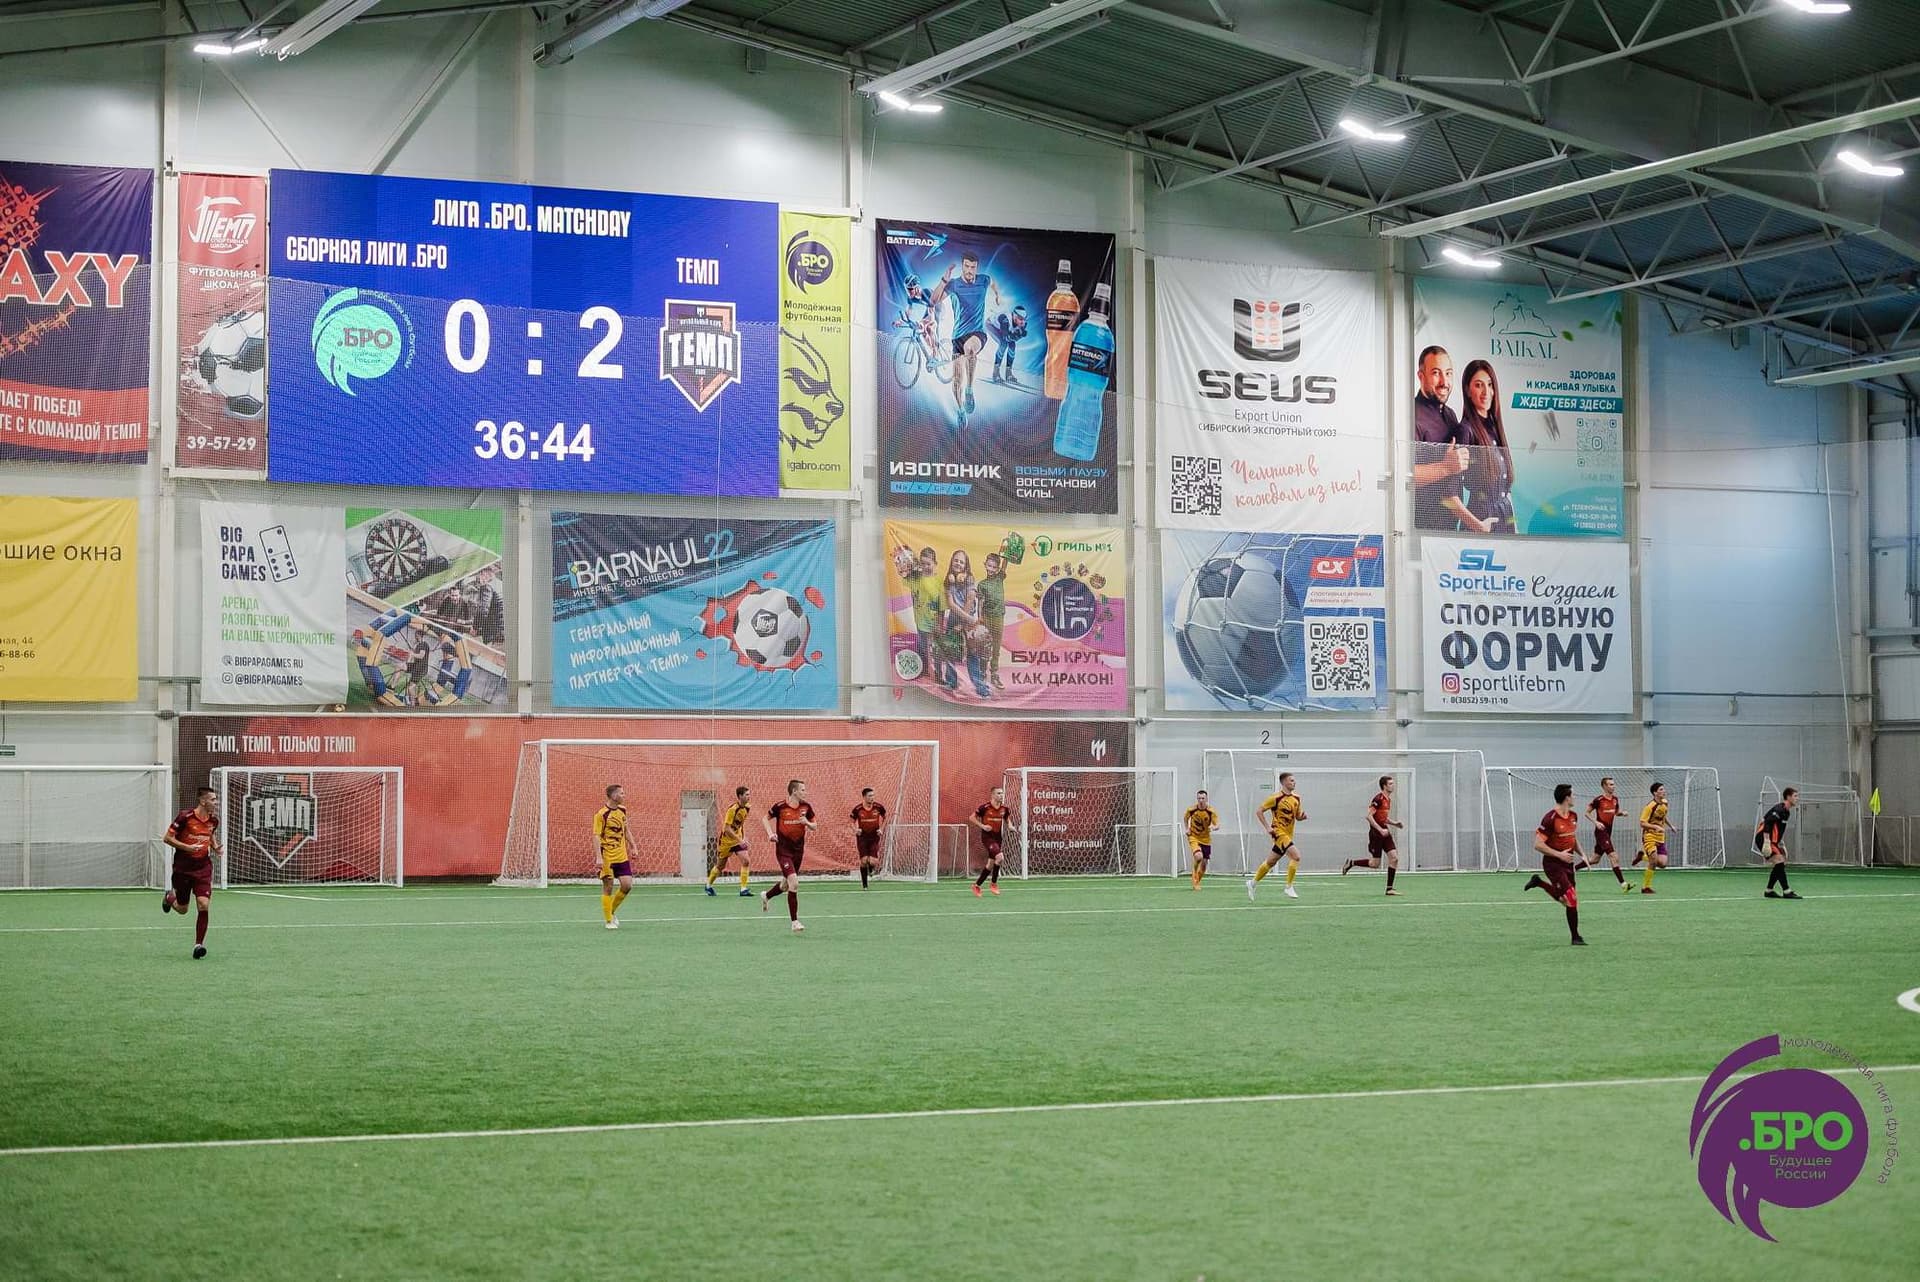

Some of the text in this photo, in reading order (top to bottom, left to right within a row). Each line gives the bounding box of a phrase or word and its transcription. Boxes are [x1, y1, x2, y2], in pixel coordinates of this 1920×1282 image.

[432, 198, 631, 238] ЛИГА .БРО. MATCHDAY
[286, 236, 447, 270] СБОРНАЯ ЛИГИ .БРО
[797, 253, 829, 269] .БРО
[188, 267, 257, 279] ФУТБОЛЬНАЯ
[676, 256, 719, 286] ТЕМП
[204, 280, 240, 290] ШКОЛА
[784, 299, 842, 313] Молодёжная
[785, 310, 842, 323] футбольная
[337, 327, 393, 350] .БРО
[444, 299, 490, 373] 0
[527, 321, 543, 376] :
[577, 306, 624, 379] 2
[820, 326, 842, 334] лига
[669, 332, 733, 371] ТЕМП
[1569, 370, 1616, 380] ЗДОРОВАЯ
[1197, 369, 1338, 404] SEUS
[1534, 381, 1580, 391] КРАСИВАЯ
[1582, 384, 1617, 393] УЛЫБКА
[33, 394, 82, 418] ПОБЕД!
[1519, 396, 1616, 411] ЖДЕТ ТЕБЯ ЗДЕСЬ!
[1234, 408, 1303, 423] Export Union
[16, 416, 25, 433] С
[28, 418, 101, 441] КОМАНДОЙ
[104, 423, 141, 440] ТЕМП!
[1198, 423, 1337, 437] СИБИРСКИЙ ЭКСПОРТНЫЙ СОЮЗ
[187, 436, 257, 451] 39-57-29
[474, 420, 595, 462] 36:44
[889, 461, 1001, 479] ИЗОТОНИК
[1015, 466, 1067, 477] ВОЗЬМИ
[1230, 454, 1320, 484] Чемпион в
[1016, 478, 1096, 488] ВОССТАНОВИ
[1235, 469, 1362, 507] каждом из нас!
[1016, 488, 1055, 498] СИЛЫ.
[220, 526, 242, 543] BIG
[0, 544, 123, 562] шие окна
[704, 528, 739, 560] 22
[1057, 542, 1093, 552] ГРИЛЬ
[221, 545, 255, 562] PAPA
[1457, 549, 1507, 571] SL
[221, 564, 266, 582] GAMES
[573, 569, 685, 598] ИНТЕРНЕТ СООБЩЕСТВО
[1439, 573, 1526, 593] SportLife
[1531, 575, 1619, 606] Создаем
[222, 596, 259, 610] АРЕНДА
[1440, 603, 1615, 628] СПОРТИВНУЮ
[569, 611, 652, 643] ГЕНЕРАЛЬНЫЙ
[221, 629, 336, 645] НА ВАШЕ МЕРОПРИЯТИЕ
[569, 628, 681, 668] ИНФОРМАЦИОННЫЙ
[1440, 631, 1614, 672] ФОРМУ
[1011, 650, 1105, 666] БУДЬ КРУТ,
[235, 674, 303, 686] @BIGPAPAGAMES
[569, 653, 689, 690] ПАРТНЕР ФК «ТЕМП»
[1011, 672, 1114, 688] КАК ДРАКОН!
[1462, 675, 1566, 694] sportlifebrn
[206, 735, 356, 754] ТЕМП, ТЕМП, ТОЛЬКО ТЕМП!
[1261, 730, 1270, 745] 2
[250, 798, 310, 830] ТЕМП
[1033, 805, 1073, 815] ФК Темп
[1033, 838, 1103, 849] fctemp_barnaul
